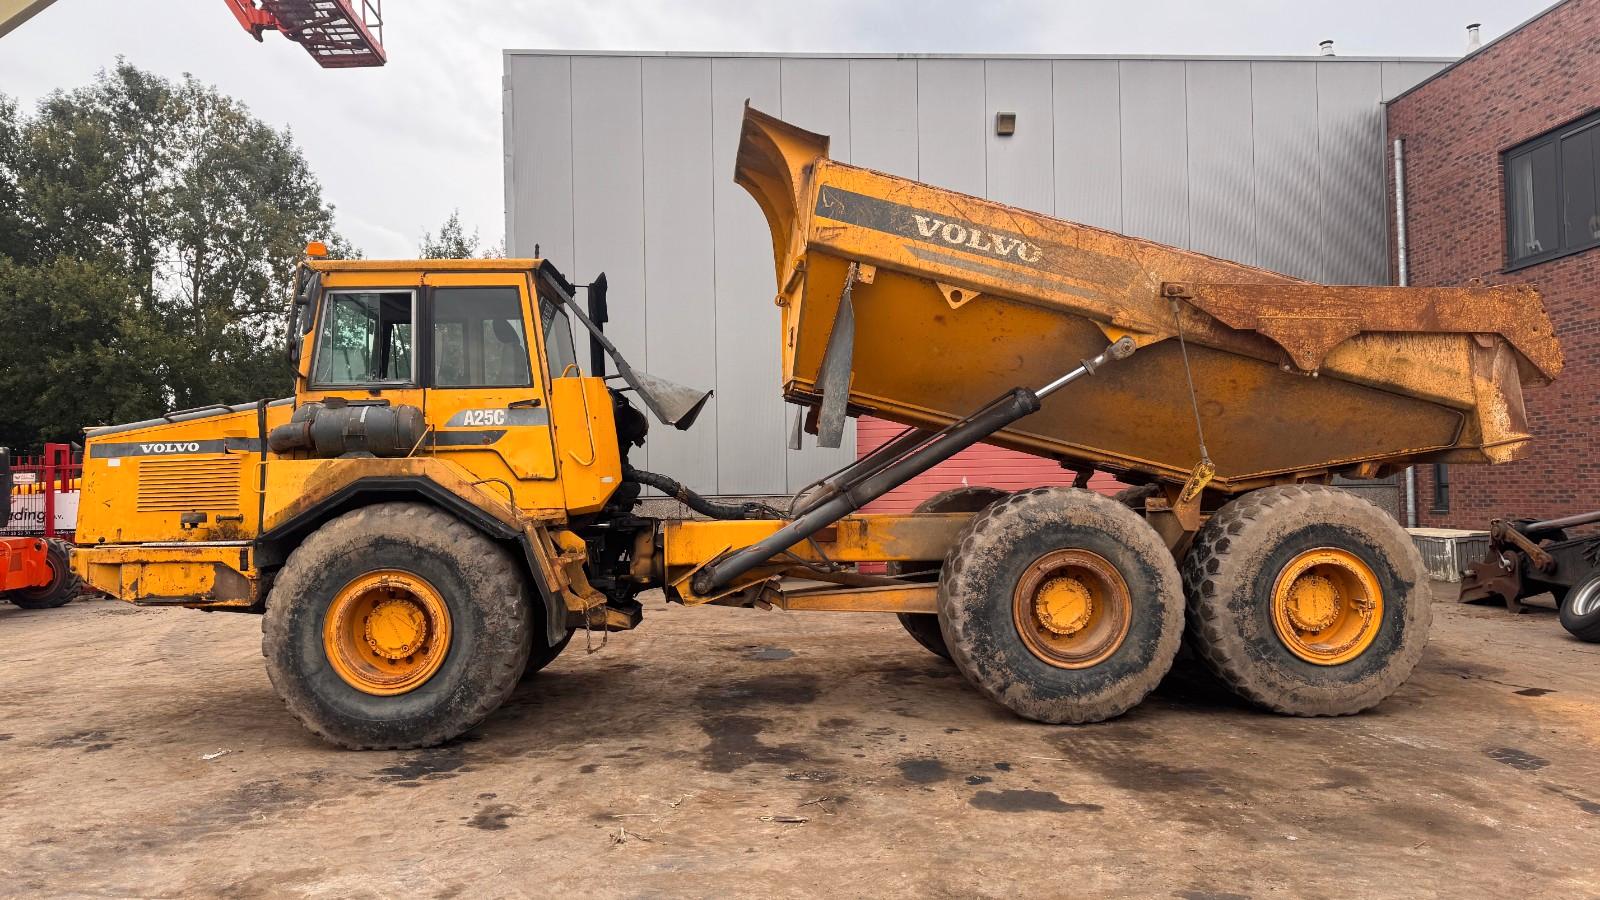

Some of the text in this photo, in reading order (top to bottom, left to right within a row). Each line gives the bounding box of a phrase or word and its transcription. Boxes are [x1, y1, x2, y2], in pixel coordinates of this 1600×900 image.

[912, 214, 1042, 263] VOLVO
[463, 409, 505, 426] A25C
[140, 442, 200, 454] VOLVO
